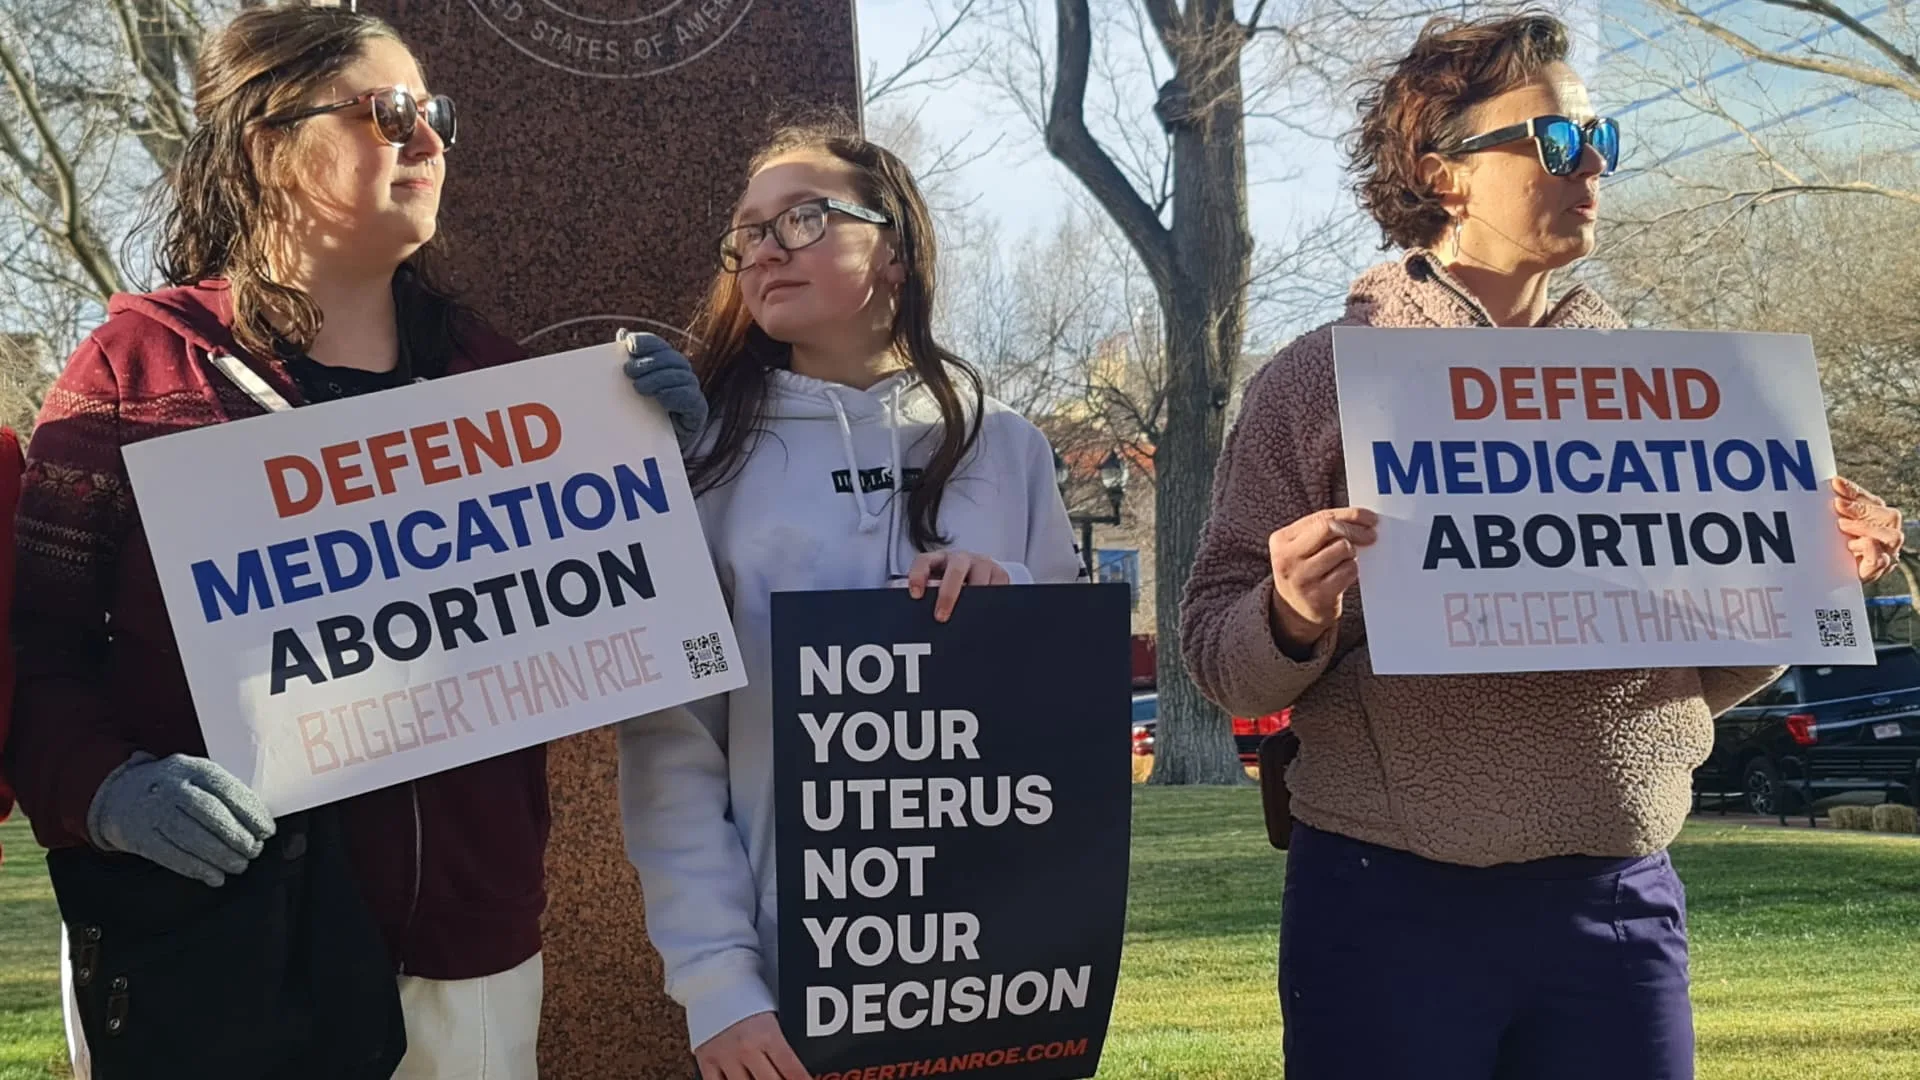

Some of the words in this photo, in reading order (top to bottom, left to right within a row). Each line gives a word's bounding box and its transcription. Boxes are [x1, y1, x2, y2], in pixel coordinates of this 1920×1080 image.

[530, 20, 620, 62] STATES
[634, 34, 665, 59] OF
[1449, 367, 1720, 421] DEFEND
[264, 402, 562, 518] DEFEND
[1372, 439, 1817, 496] MEDICATION
[191, 457, 670, 623] MEDICATION
[1422, 511, 1795, 570] ABORTION
[269, 542, 657, 695] ABORTION
[1443, 590, 1604, 648] BIGGER
[1603, 588, 1718, 643] THAN
[1720, 586, 1792, 641] ROE
[799, 642, 932, 696] NOT
[297, 676, 475, 776] BIGGER
[467, 646, 590, 727] THAN
[584, 627, 663, 697] ROE
[798, 709, 981, 763] YOUR
[802, 775, 1053, 832] UTERUS
[804, 845, 936, 900] NOT
[802, 911, 981, 968] YOUR
[806, 964, 1092, 1037] DECISION
